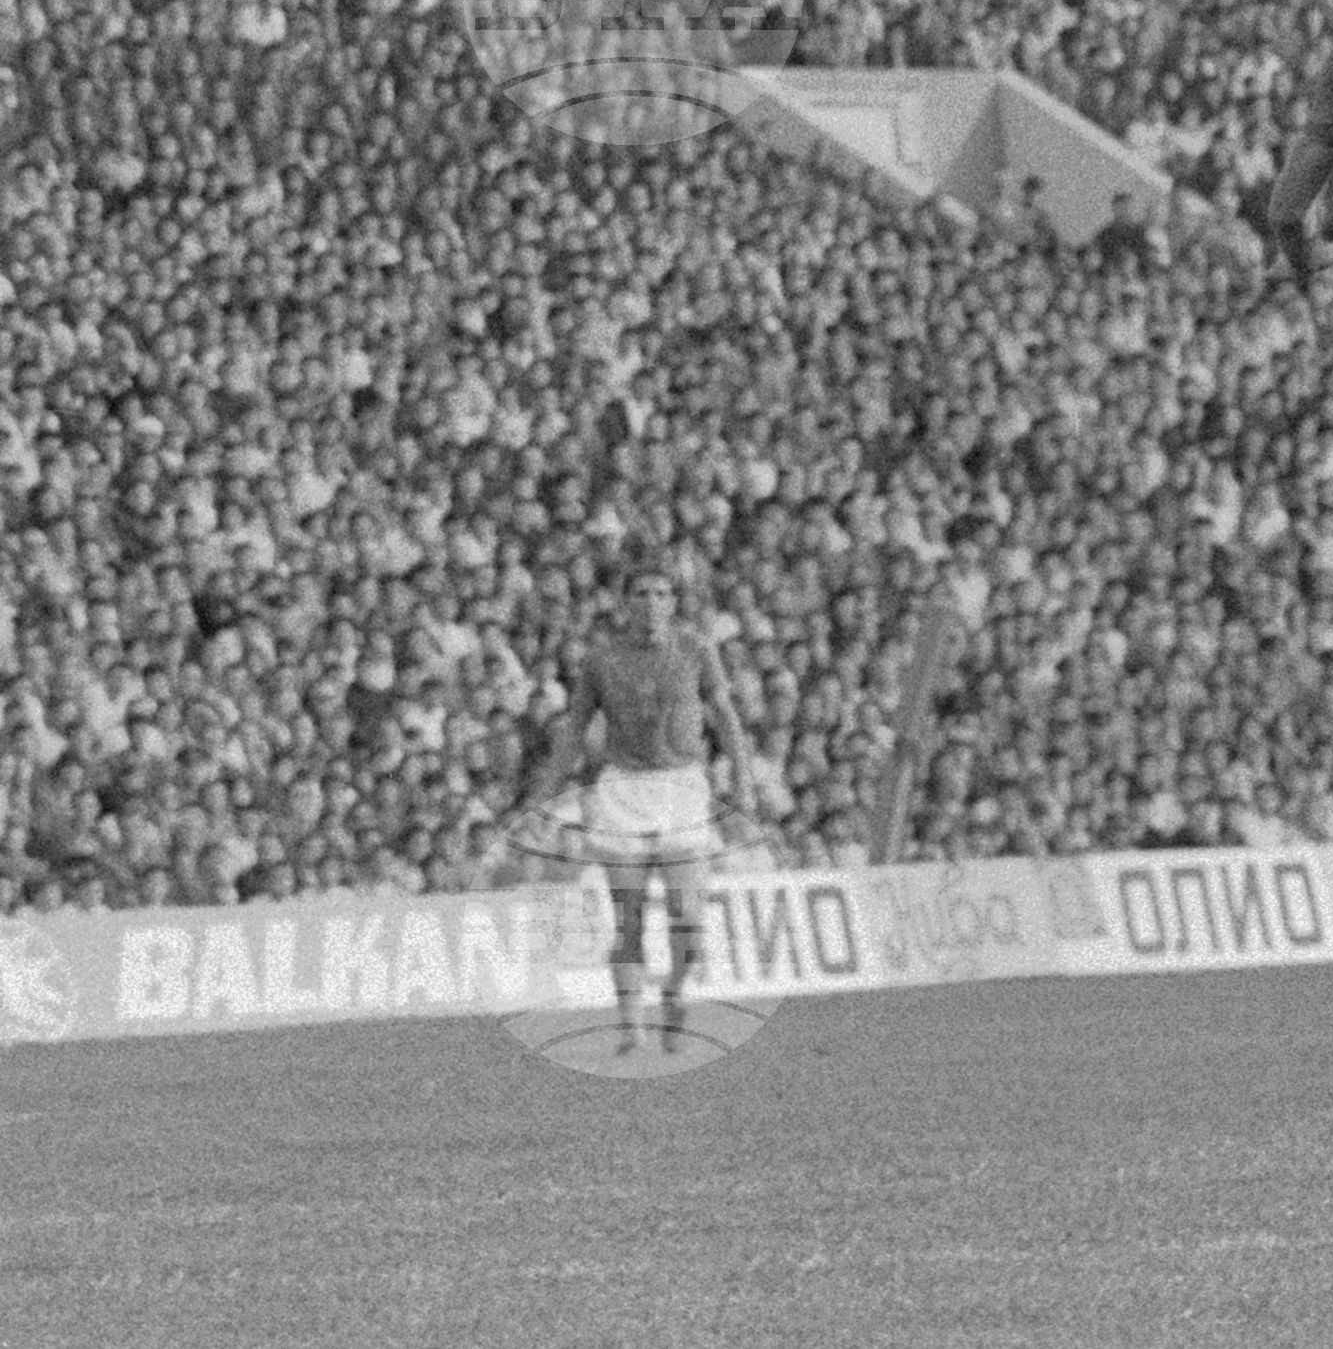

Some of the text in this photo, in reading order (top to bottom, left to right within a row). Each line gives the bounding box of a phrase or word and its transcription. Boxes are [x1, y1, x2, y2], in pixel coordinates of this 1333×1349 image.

[645, 885, 862, 982] ЛИО
[1117, 860, 1322, 954] ОЛИО
[116, 904, 532, 1022] BALKAN
